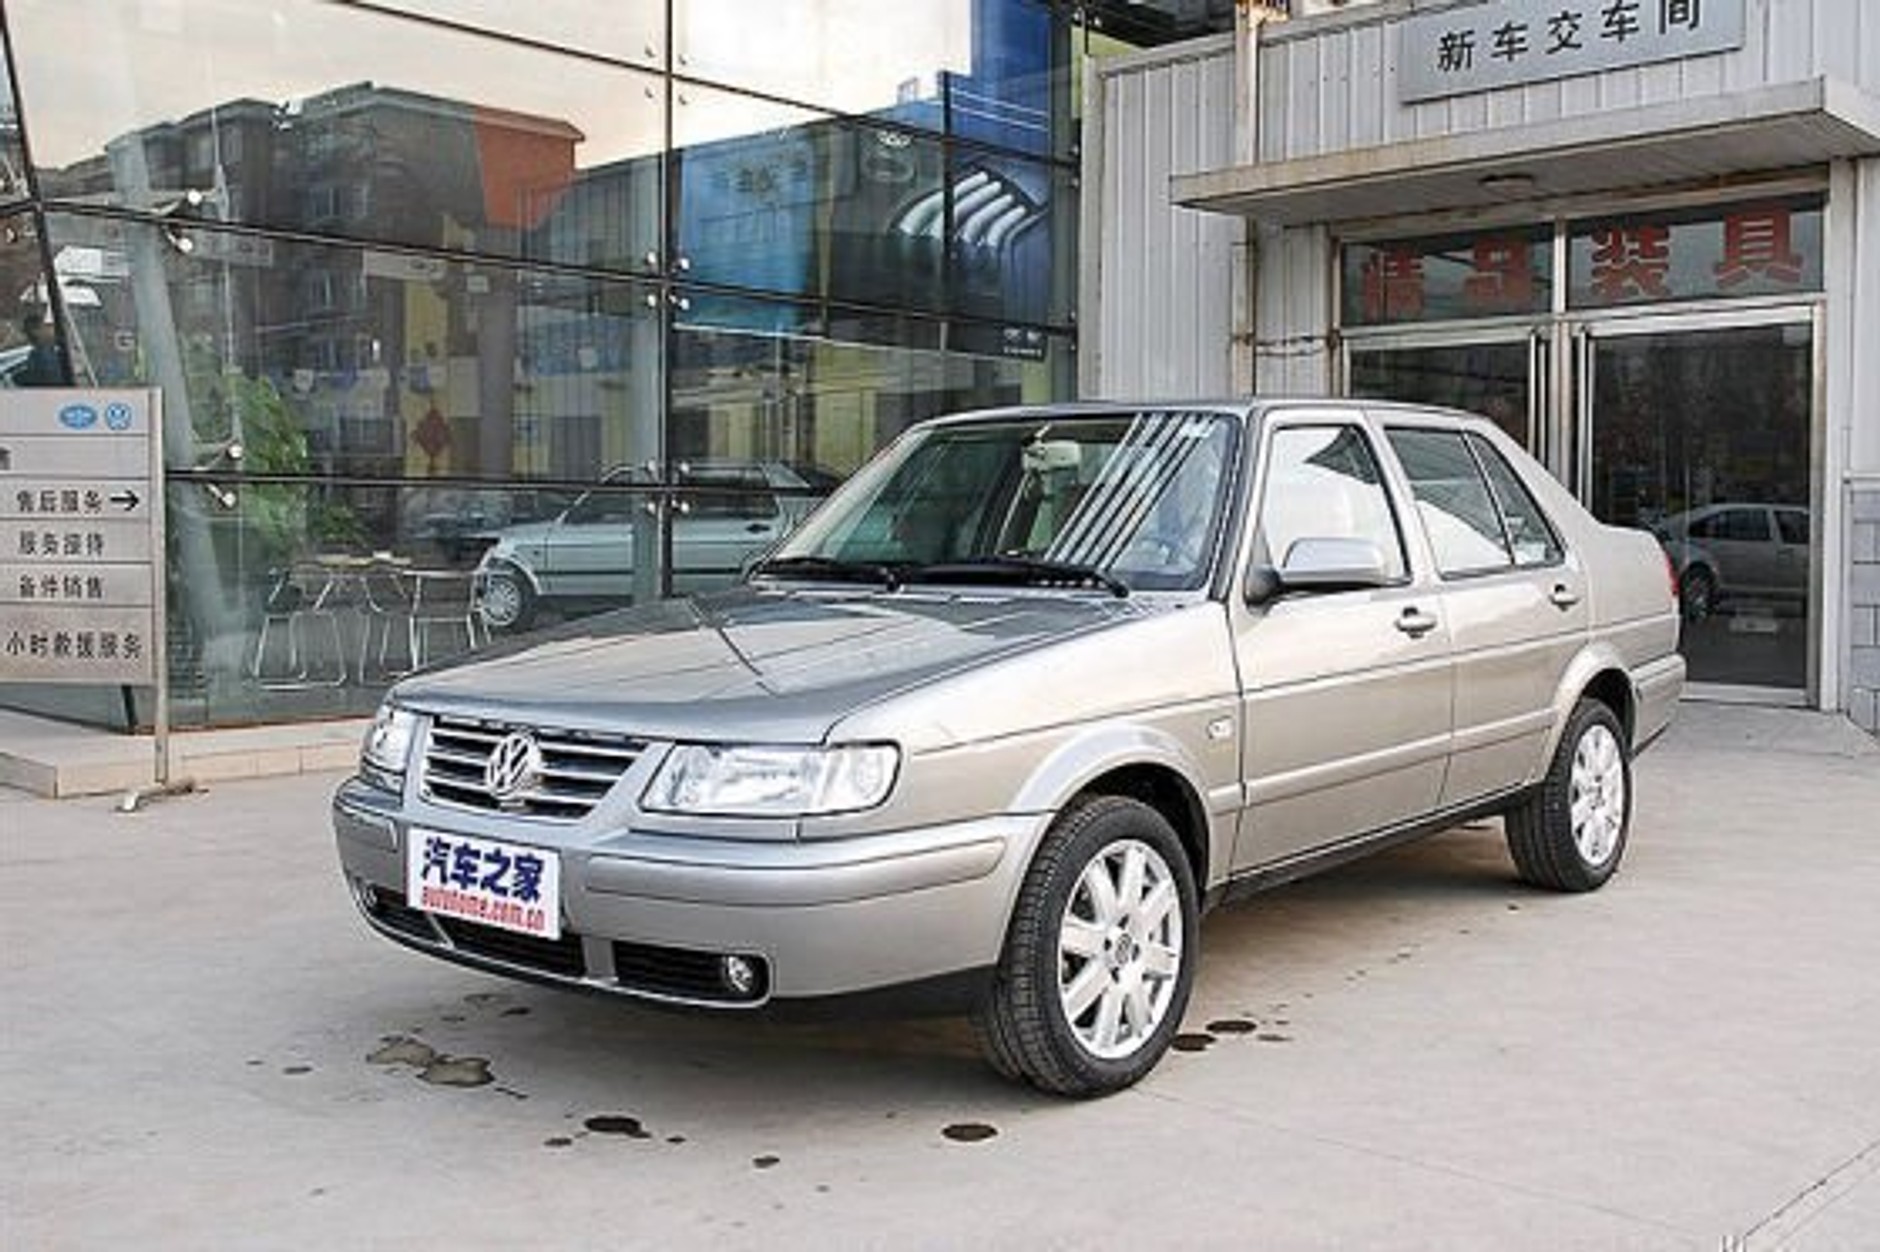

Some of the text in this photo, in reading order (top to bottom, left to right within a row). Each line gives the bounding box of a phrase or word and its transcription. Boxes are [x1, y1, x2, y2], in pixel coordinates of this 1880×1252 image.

[1437, 0, 1700, 72] 新车交车间
[16, 489, 102, 514] 售后服务
[6, 630, 142, 659] 小时救援服务
[421, 836, 544, 902] 汽车之家
